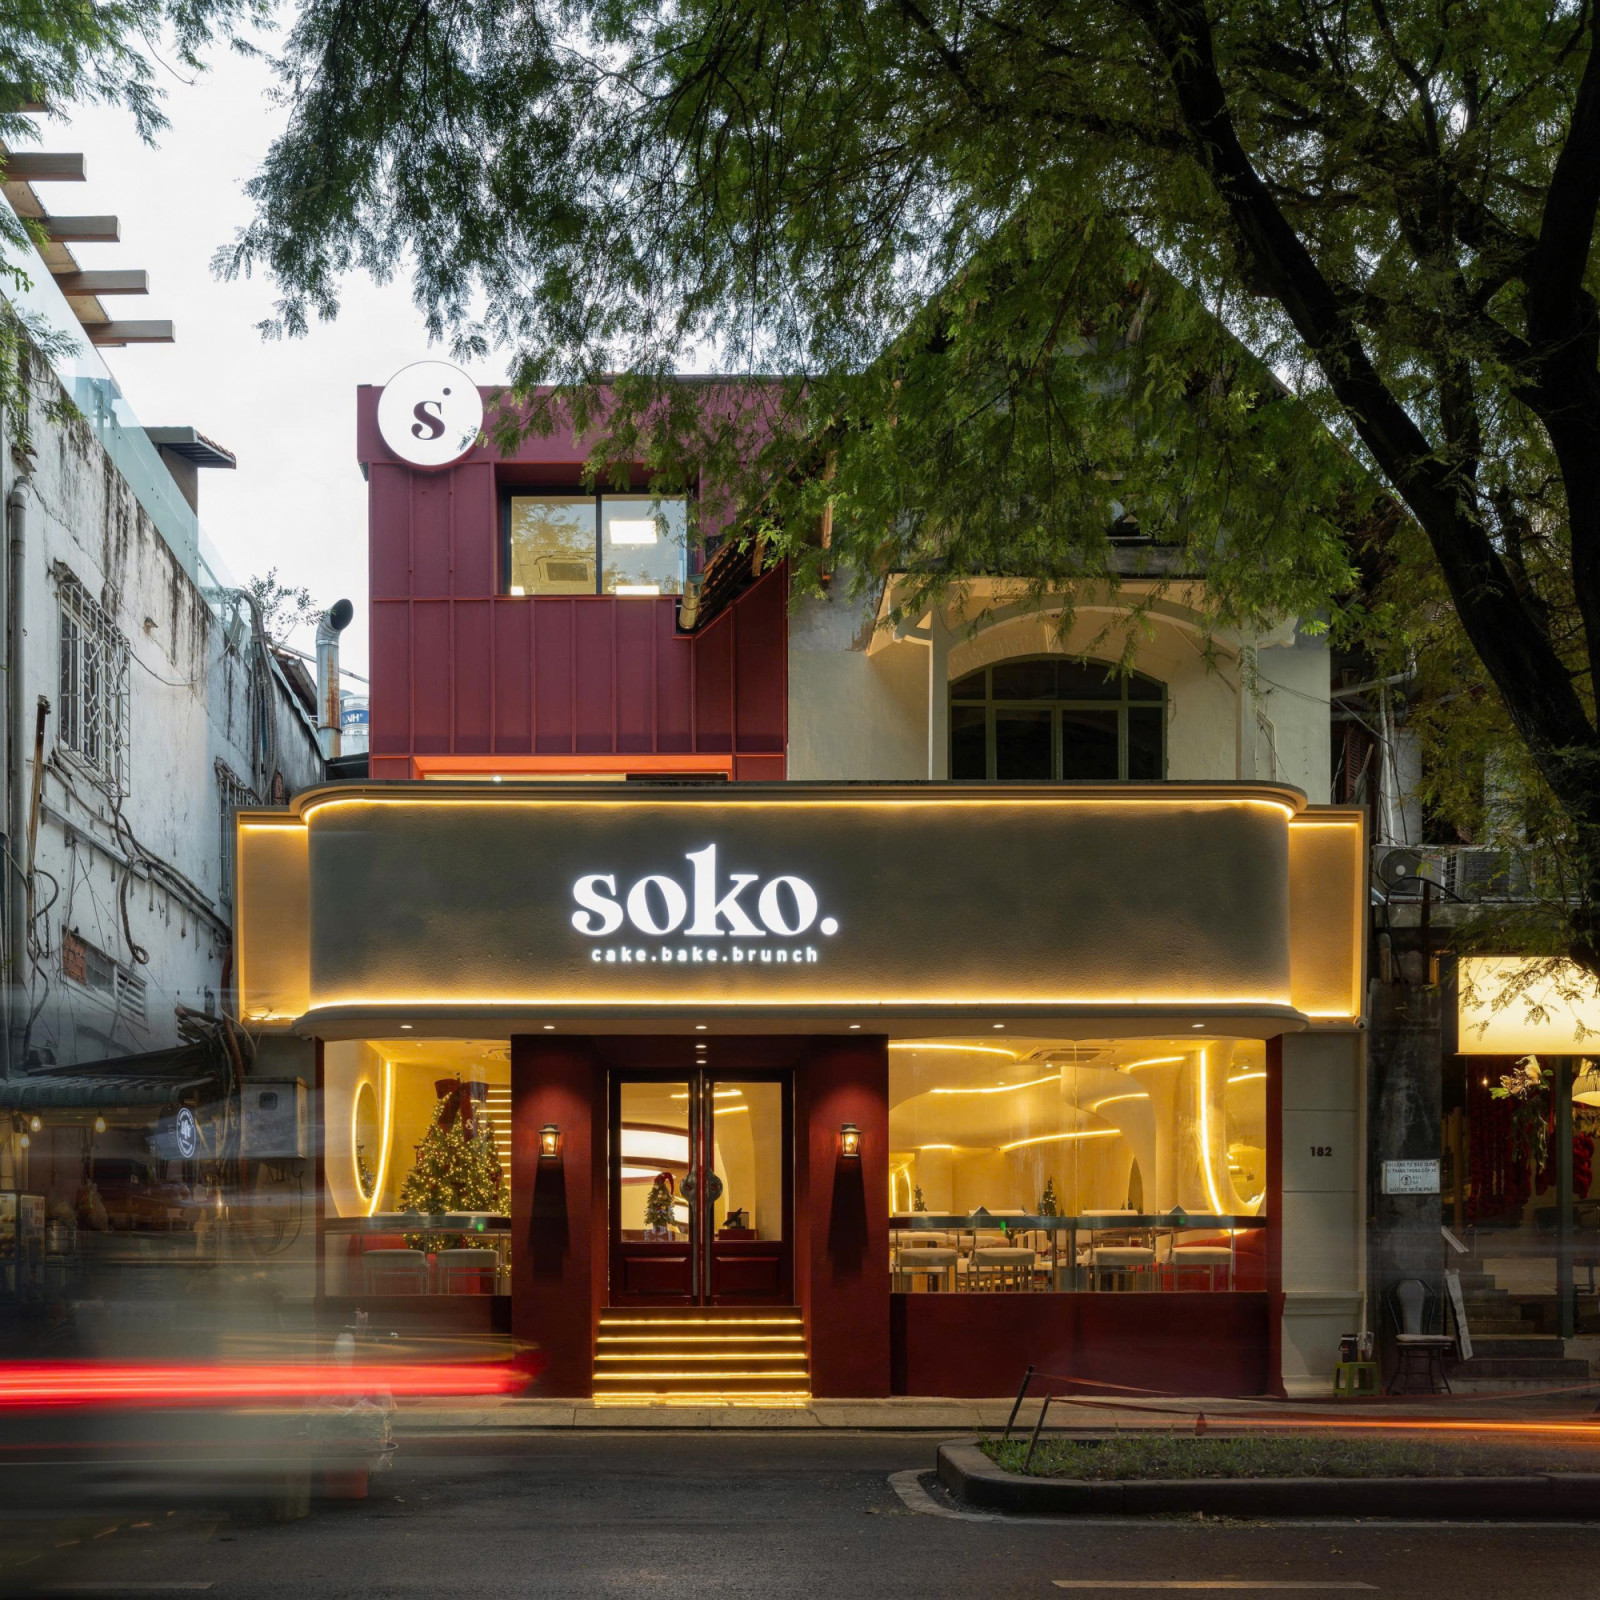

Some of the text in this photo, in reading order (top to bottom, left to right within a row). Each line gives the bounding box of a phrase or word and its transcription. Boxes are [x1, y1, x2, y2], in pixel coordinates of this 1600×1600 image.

[571, 843, 839, 937] soko.
[591, 946, 818, 963] cake.bake.brunch
[1310, 1146, 1333, 1157] 182
